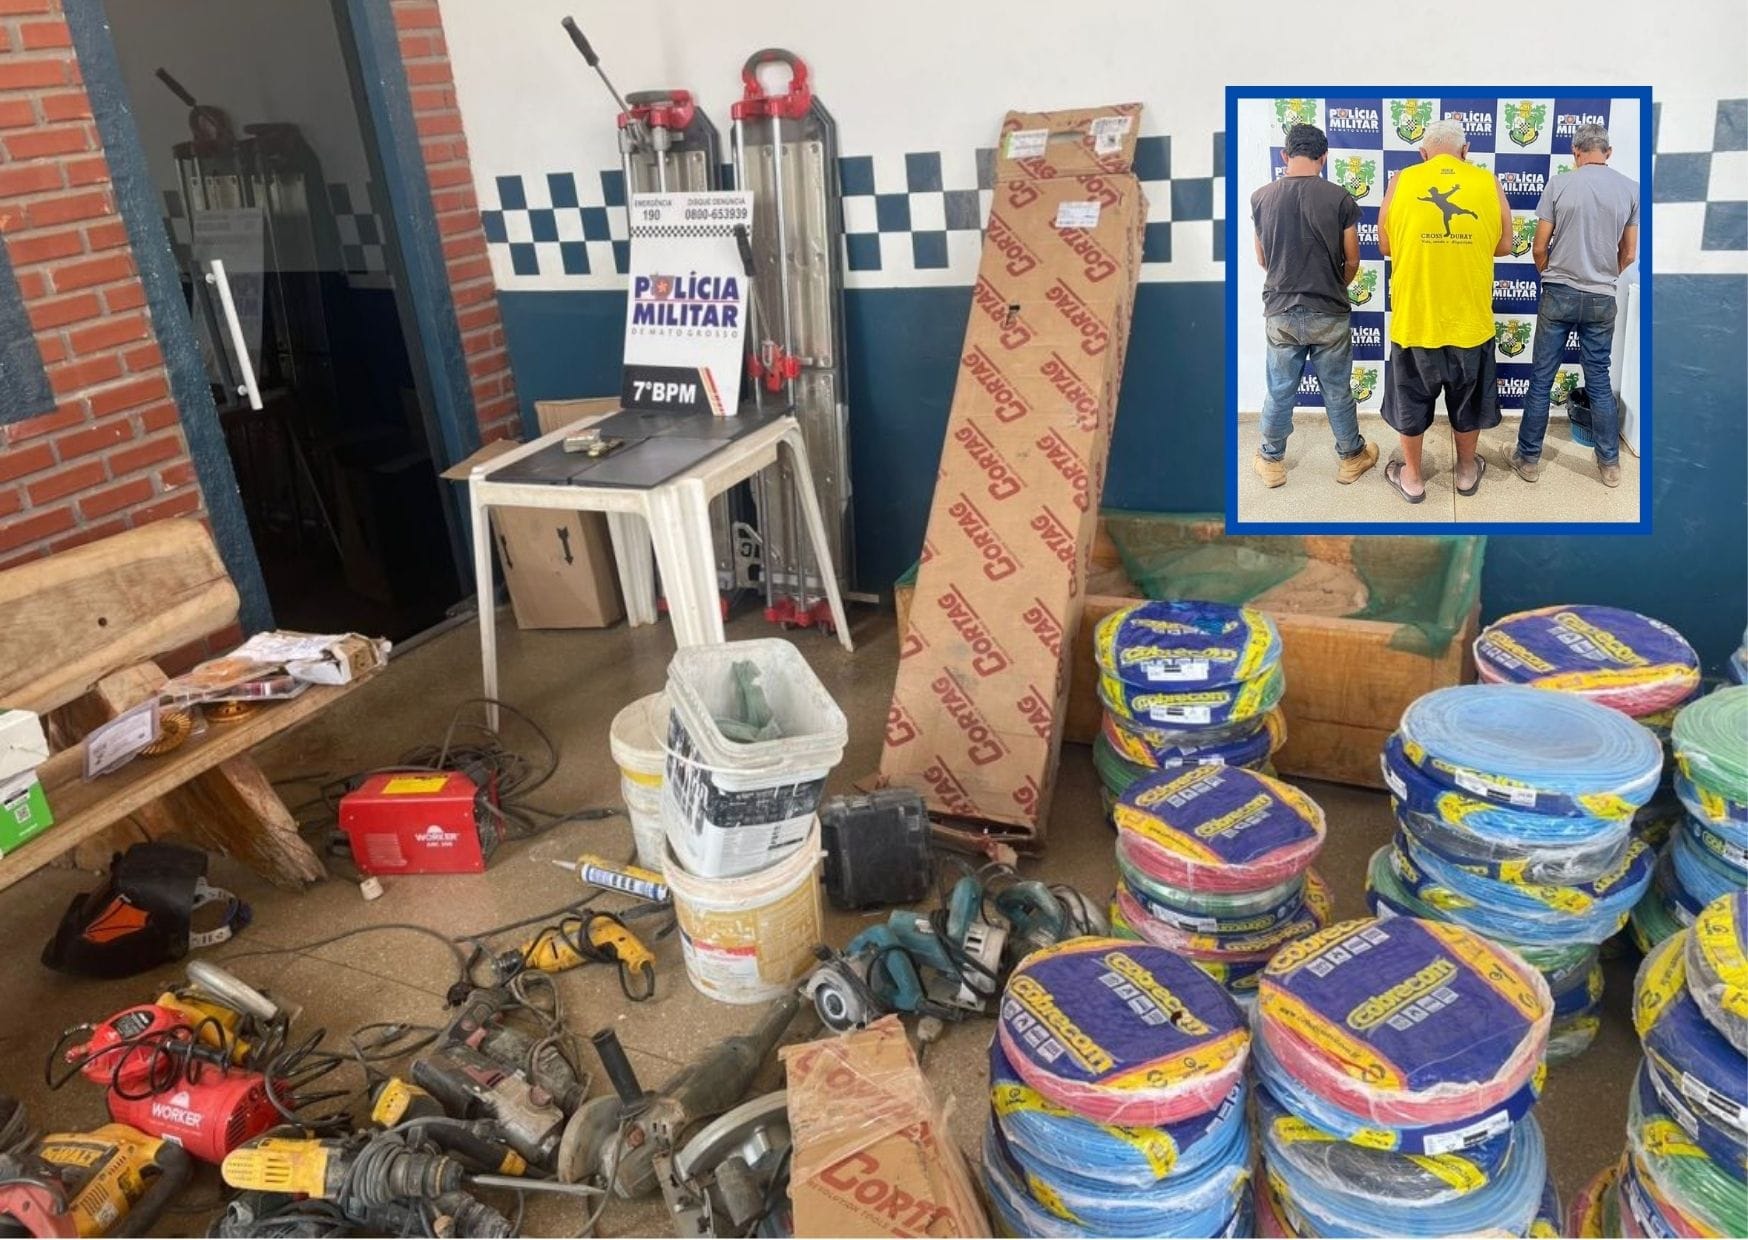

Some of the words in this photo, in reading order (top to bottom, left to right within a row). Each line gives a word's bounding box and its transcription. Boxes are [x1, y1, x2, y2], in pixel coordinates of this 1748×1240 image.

[1330, 119, 1378, 129] MILITAR
[1460, 122, 1492, 132] LITAR
[643, 208, 661, 221] 190
[685, 207, 748, 221] 0800-653939
[633, 303, 739, 327] MILITAR
[1492, 289, 1537, 298] MILITAR
[1045, 286, 1108, 356] CORTAG
[1351, 336, 1381, 344] LITAR
[1352, 325, 1380, 336] LÍCIA
[962, 353, 1027, 423] CORTAG
[954, 427, 1021, 500] CORTAG
[1036, 434, 1089, 513] CORTAG
[948, 502, 1017, 581] CORTAG
[938, 592, 1007, 678] CORTAG
[931, 675, 1004, 767] CORTAG
[1349, 958, 1458, 1029] cobrecom
[1010, 977, 1114, 1074] cobrecom
[152, 1102, 203, 1127] WORKER
